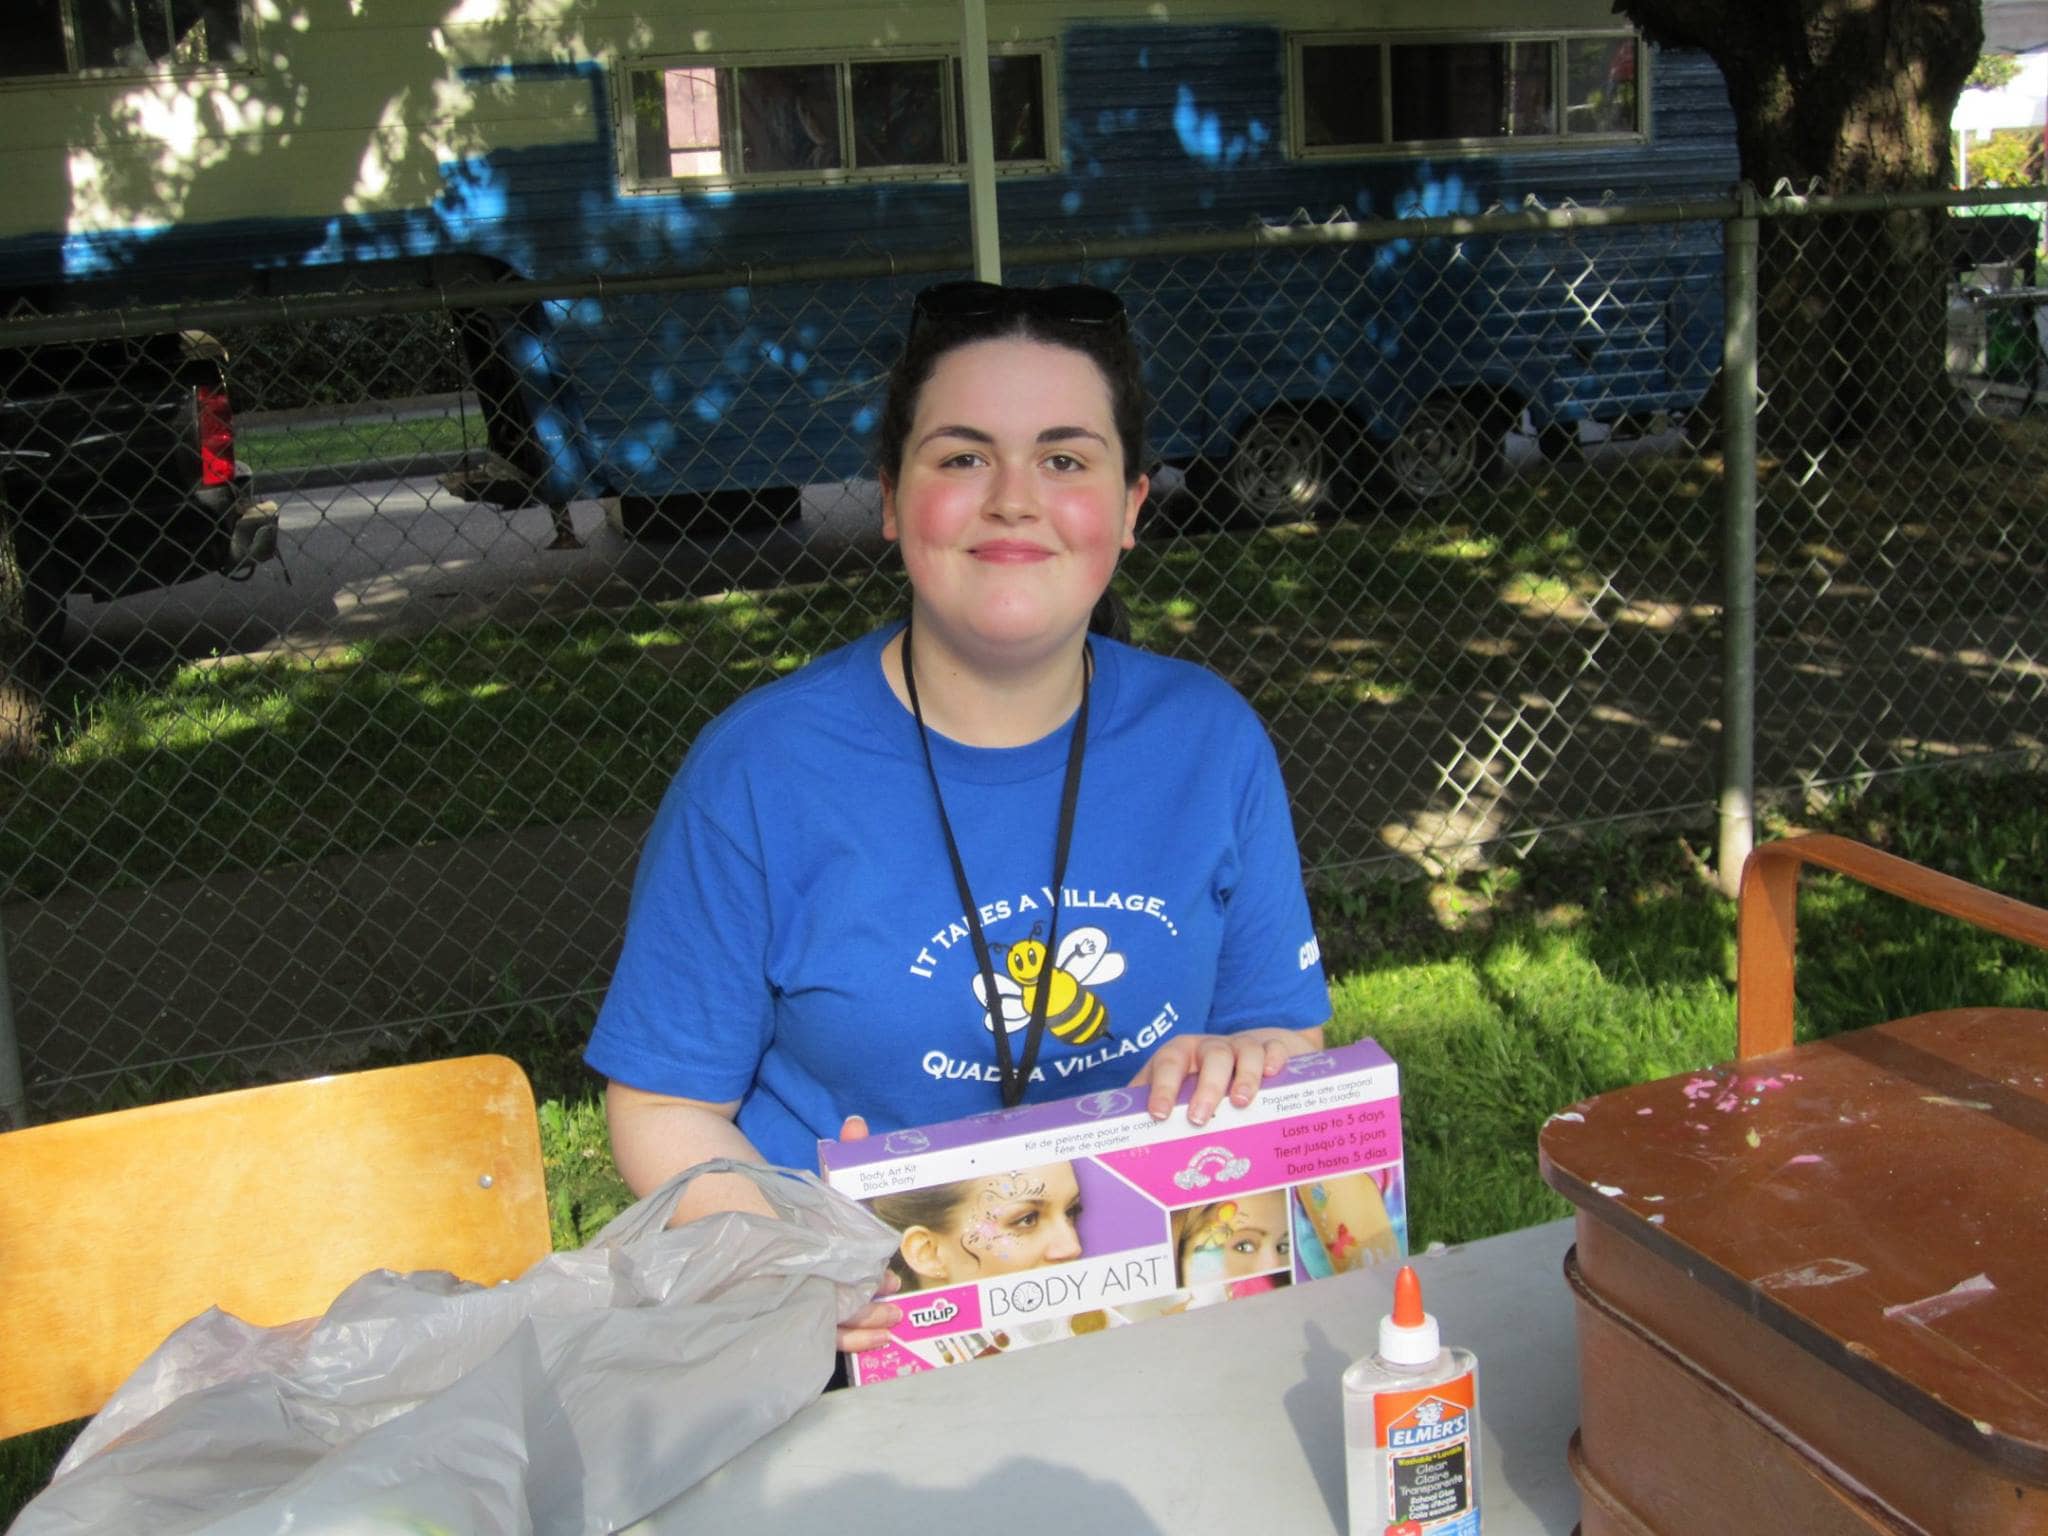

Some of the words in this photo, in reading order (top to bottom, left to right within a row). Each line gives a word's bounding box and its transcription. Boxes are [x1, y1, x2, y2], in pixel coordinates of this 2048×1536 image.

[910, 947, 937, 978] IT
[1018, 894, 1039, 912] A
[1054, 1002, 1180, 1078] VILLAGE!
[1303, 1089, 1314, 1098] de
[1025, 1140, 1037, 1152] Kit
[1040, 1138, 1052, 1148] de
[1097, 1127, 1119, 1140] pour
[1121, 1123, 1130, 1132] le
[1282, 1125, 1309, 1138] Lasts
[1313, 1123, 1328, 1133] up
[1331, 1119, 1343, 1129] to
[1358, 1110, 1385, 1123] days
[1079, 1142, 1092, 1151] de
[1273, 1145, 1302, 1159] Tient
[1359, 1129, 1387, 1145] jours
[860, 1169, 884, 1182] Body
[1287, 1162, 1314, 1175] Dura
[1318, 1155, 1349, 1169] hasta
[989, 1271, 1088, 1317] BODY
[1100, 1256, 1162, 1296] ART
[1393, 1415, 1465, 1445] ELMER'S
[1415, 1471, 1450, 1485] Claire
[1416, 1461, 1448, 1475] Clear
